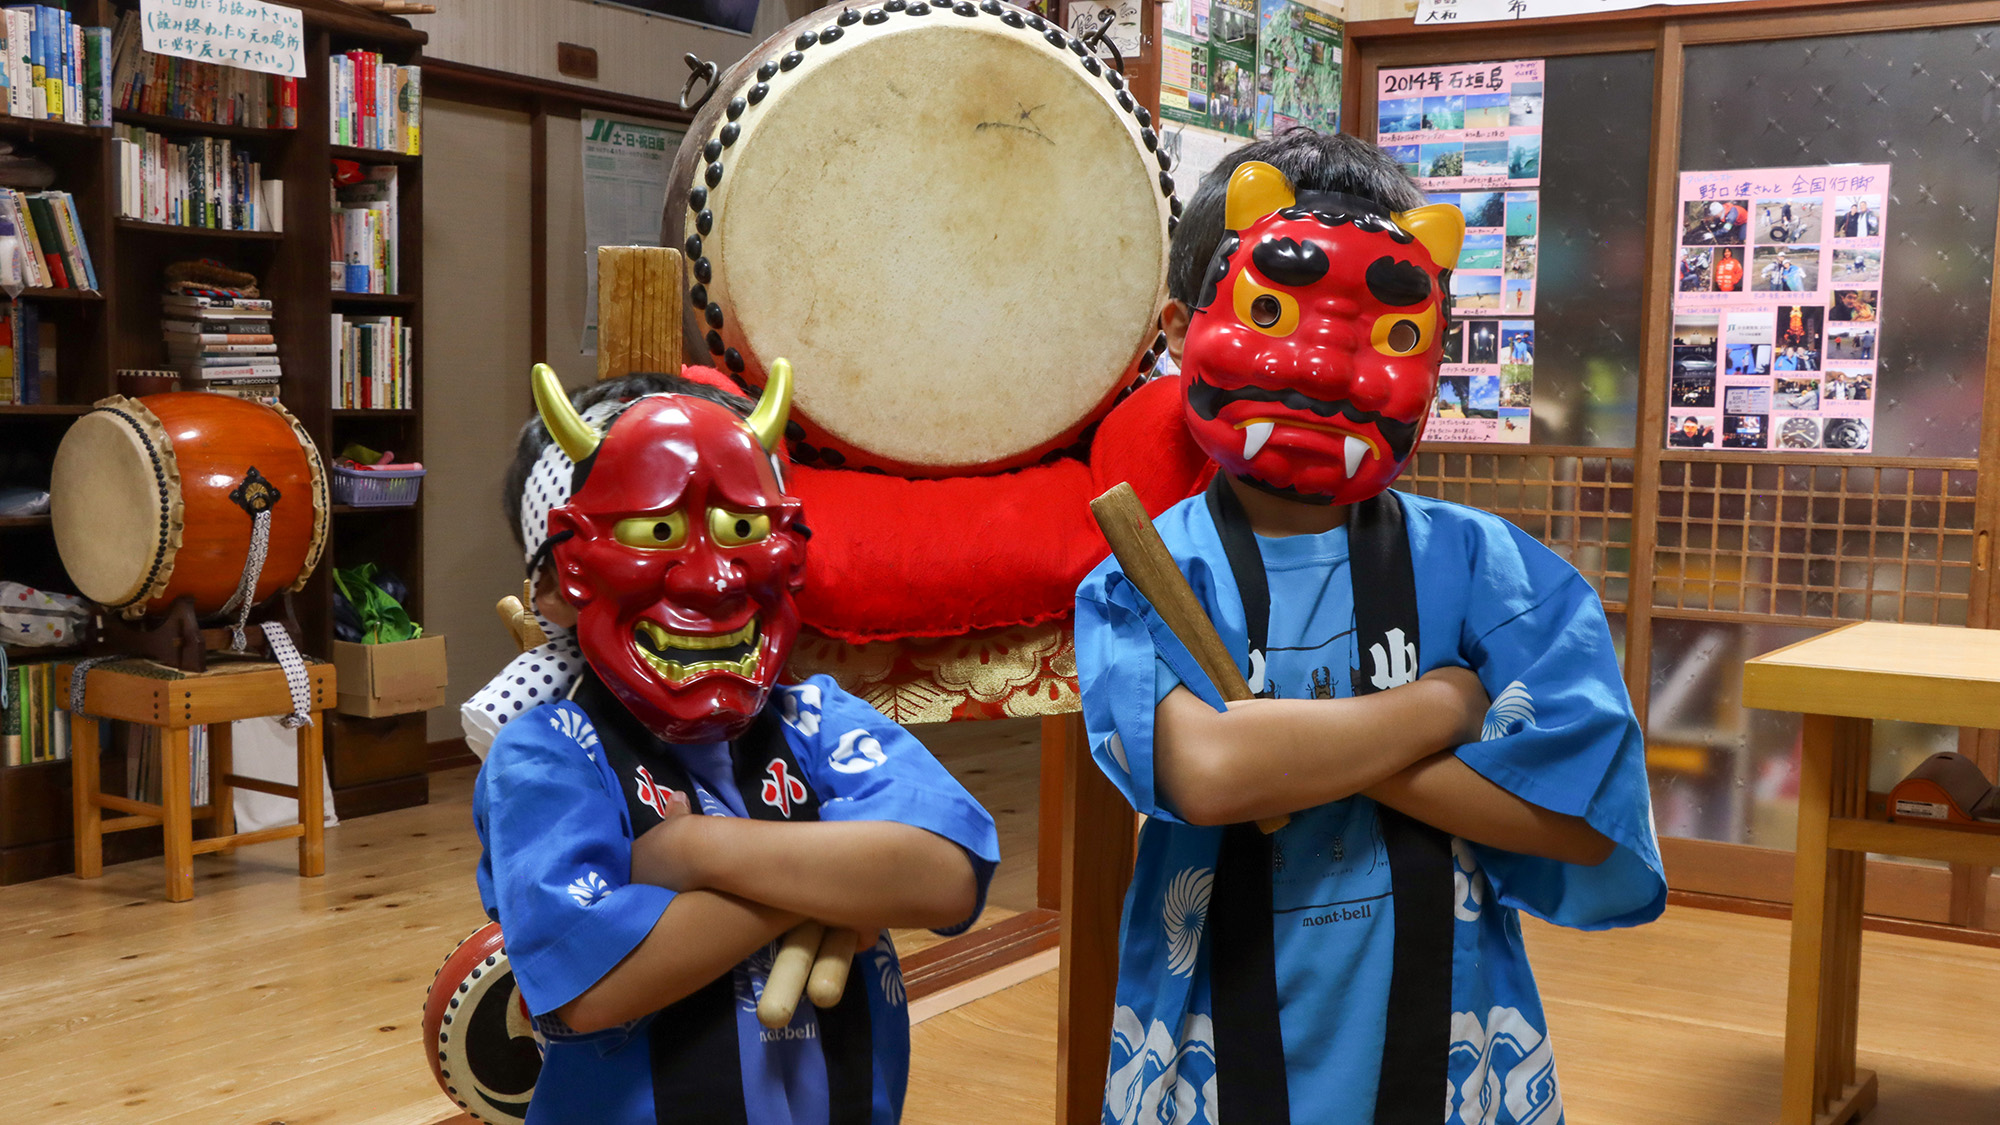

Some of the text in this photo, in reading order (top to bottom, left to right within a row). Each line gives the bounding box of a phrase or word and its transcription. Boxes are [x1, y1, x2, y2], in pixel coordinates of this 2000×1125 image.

[1424, 10, 1457, 22] 大和
[1384, 71, 1443, 93] 2014年
[1448, 65, 1504, 91] 石垣島
[1792, 175, 1875, 195] 全国行脚
